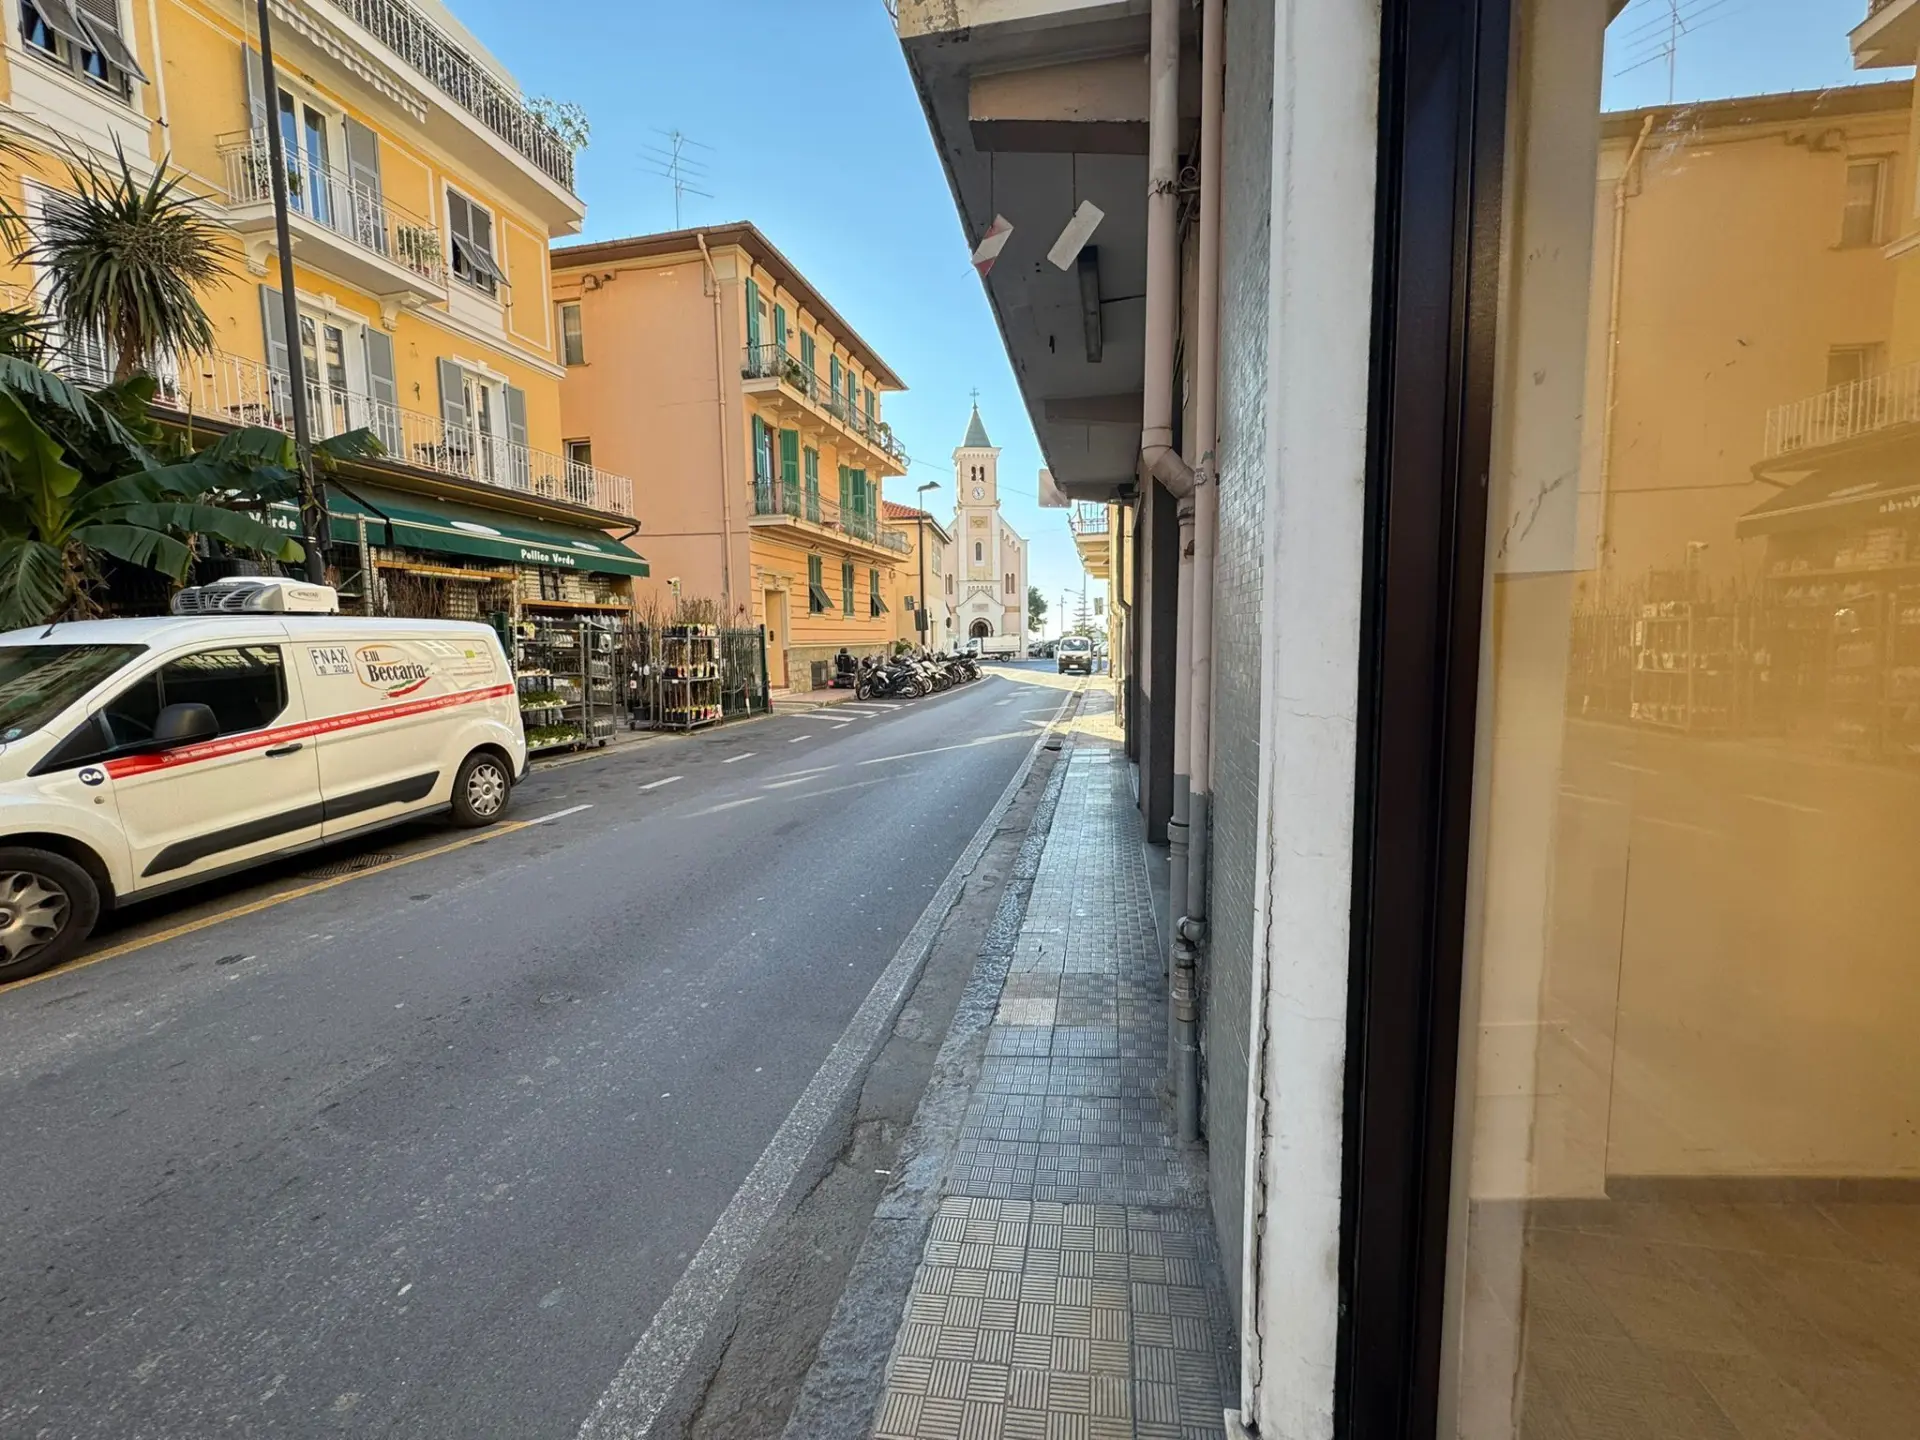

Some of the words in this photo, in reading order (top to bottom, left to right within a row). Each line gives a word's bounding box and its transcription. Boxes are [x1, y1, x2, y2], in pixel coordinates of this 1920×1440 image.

[248, 511, 297, 530] Vrde
[521, 549, 550, 562] Pollice
[552, 553, 575, 566] Verde
[311, 649, 348, 665] FNAX
[334, 664, 349, 673] 2022
[367, 662, 425, 682] Beccaria
[81, 772, 102, 782] 04
